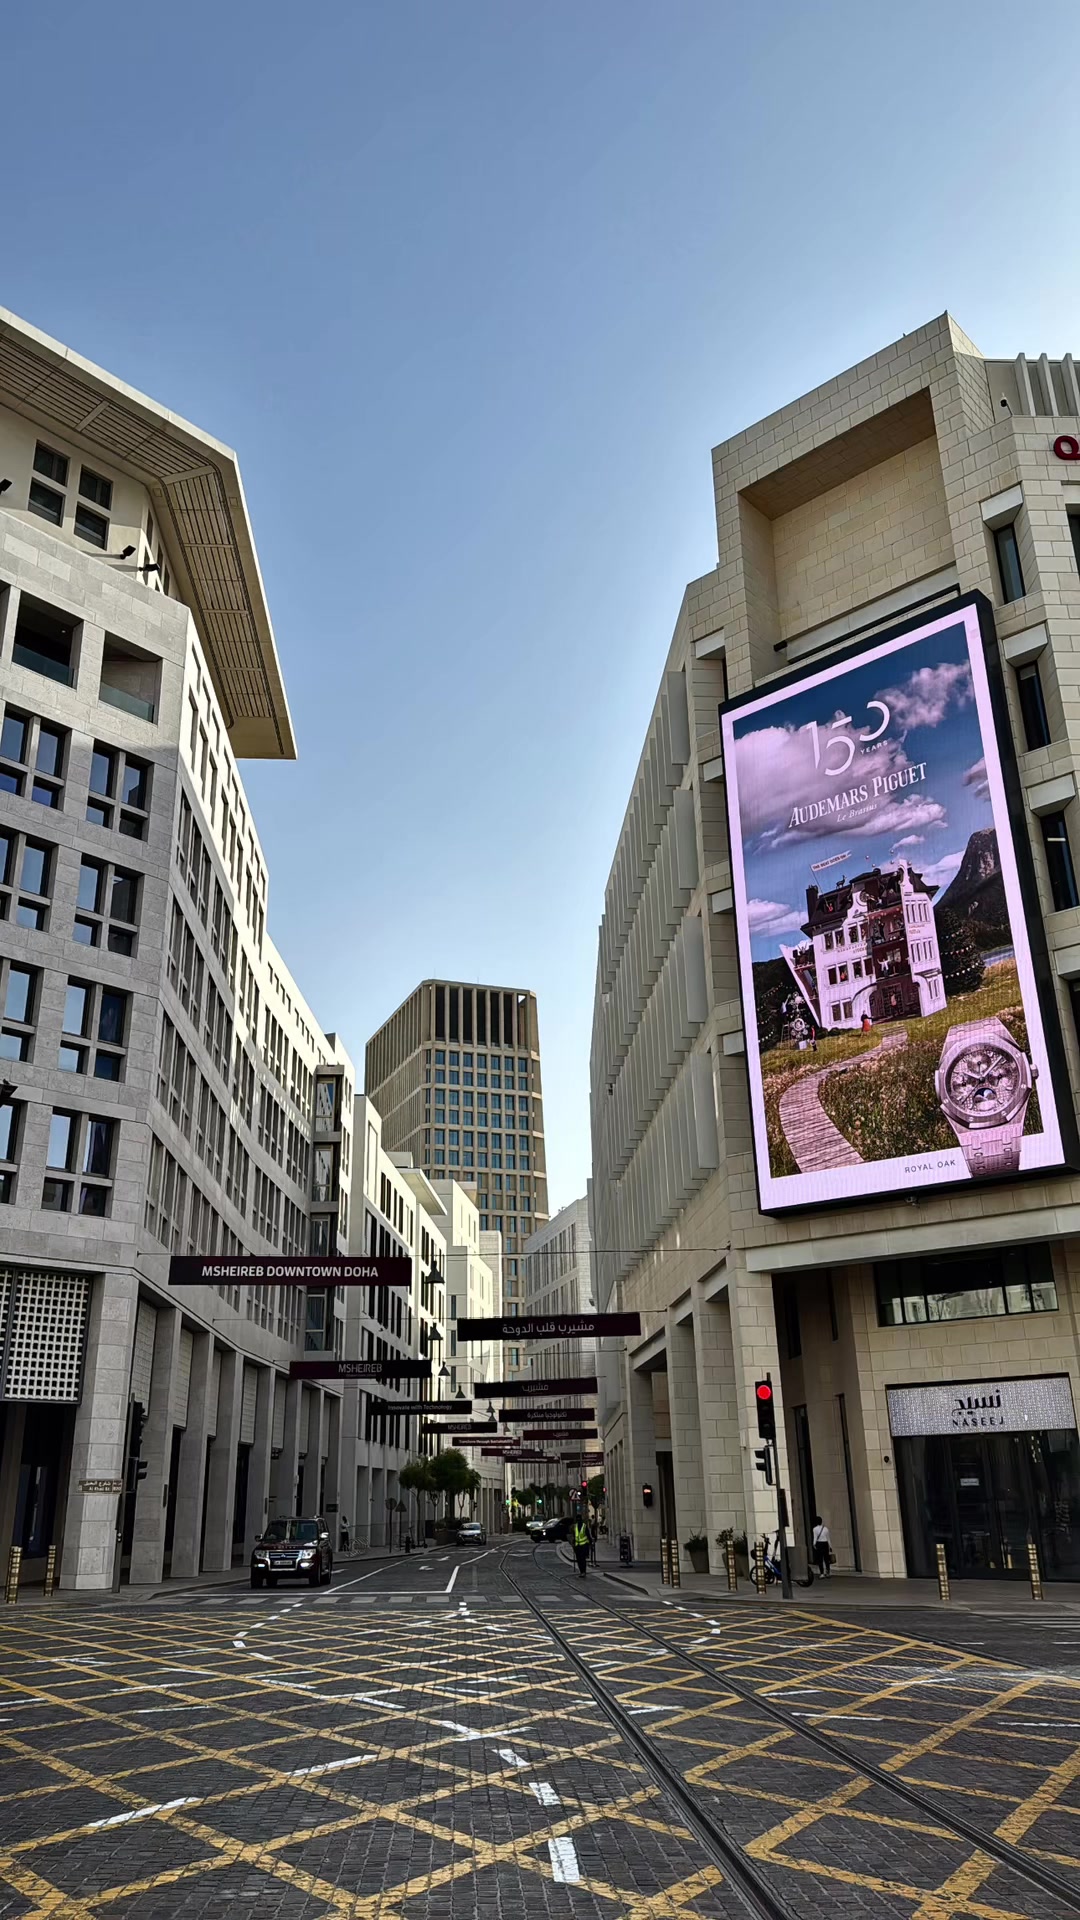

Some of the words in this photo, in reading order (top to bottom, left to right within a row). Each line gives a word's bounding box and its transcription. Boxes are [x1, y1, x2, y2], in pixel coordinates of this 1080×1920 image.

[860, 740, 888, 755] YEARS
[788, 784, 868, 828] AUDEMARS
[872, 762, 927, 798] PIGUET
[904, 1163, 934, 1173] ROYAL
[937, 1159, 956, 1169] OAK
[201, 1265, 264, 1277] MSHEIREB
[266, 1265, 341, 1277] DOWNTOWN
[344, 1266, 379, 1277] DOHA
[502, 1323, 533, 1336] الدوحة
[536, 1322, 556, 1333] قلب
[558, 1320, 595, 1334] مشيرب
[338, 1363, 383, 1373] MSHEIREB
[952, 1389, 1001, 1416] نسيج
[952, 1416, 1004, 1427] NASEEJ
